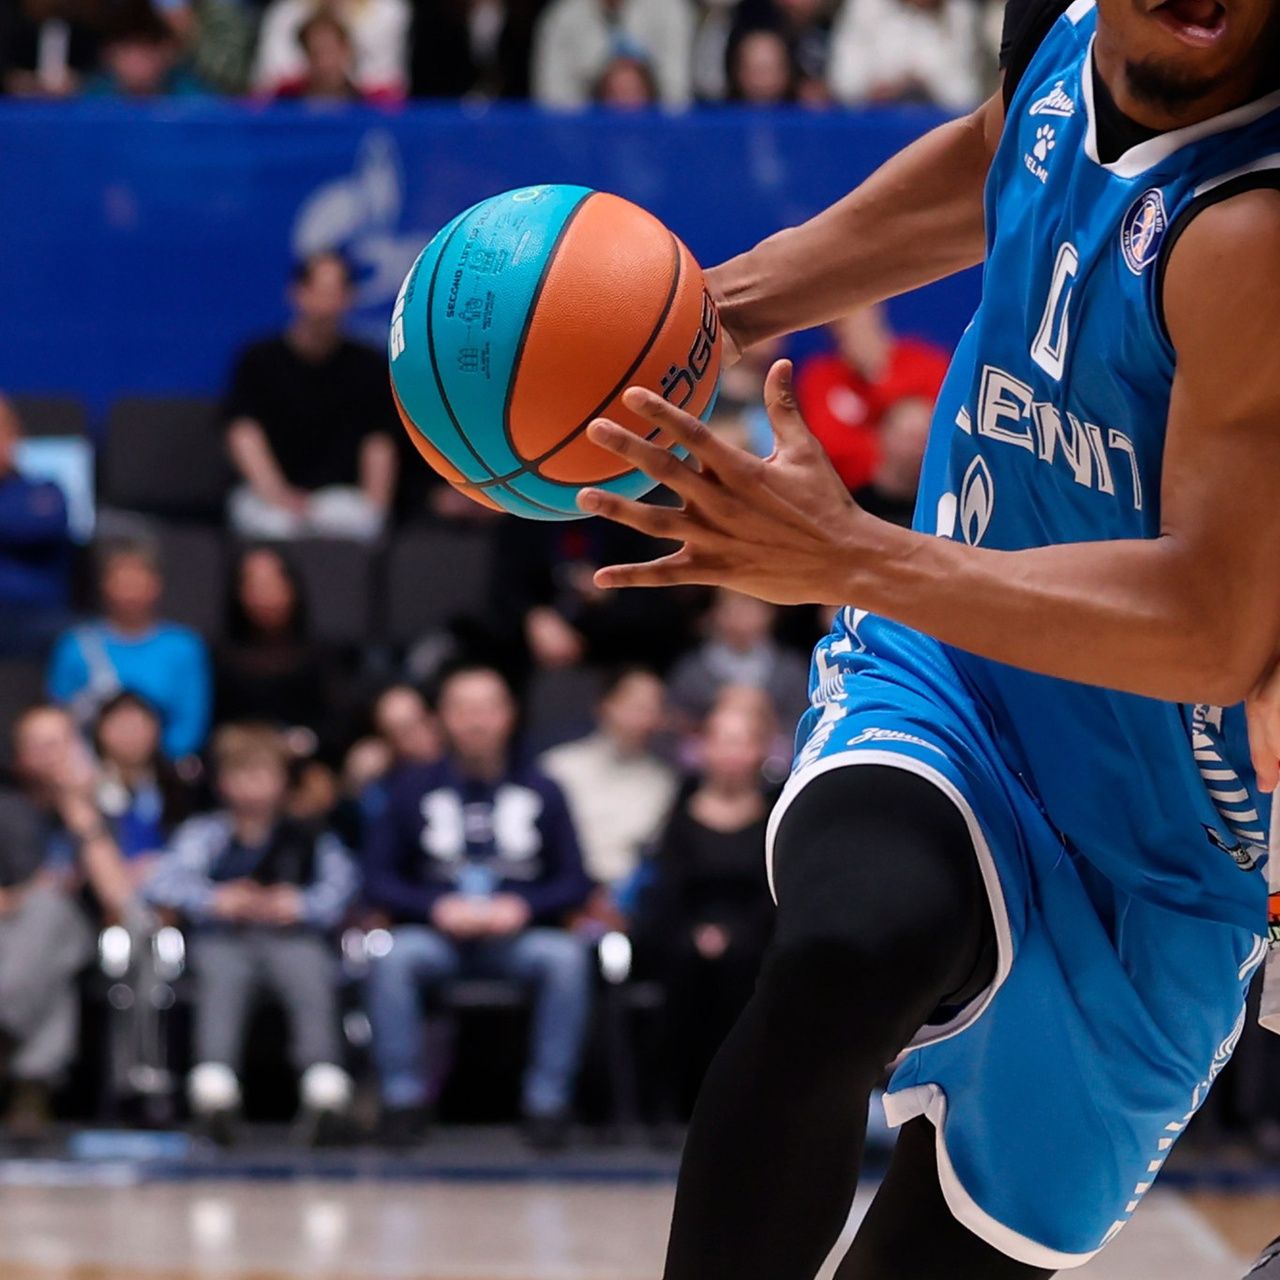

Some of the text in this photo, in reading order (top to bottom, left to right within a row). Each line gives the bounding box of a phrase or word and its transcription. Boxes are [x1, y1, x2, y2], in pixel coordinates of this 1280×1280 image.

[446, 269, 464, 318] SECOND
[457, 242, 475, 266] LIFE
[646, 288, 718, 439] ÖGE
[955, 364, 1142, 511] ENIT
